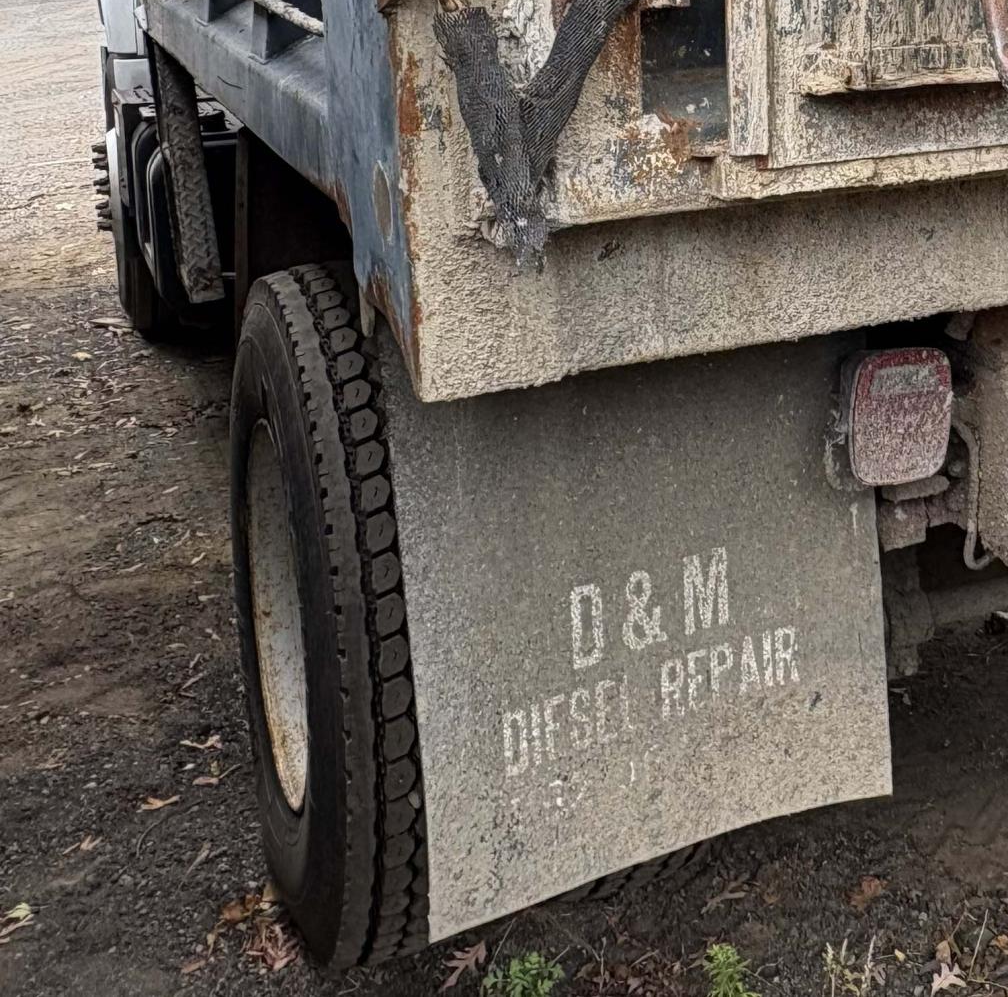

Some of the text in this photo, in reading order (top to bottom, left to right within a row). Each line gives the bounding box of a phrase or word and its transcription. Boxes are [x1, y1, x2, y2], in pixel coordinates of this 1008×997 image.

[571, 547, 729, 670] D & M
[660, 625, 800, 721] REPAIR
